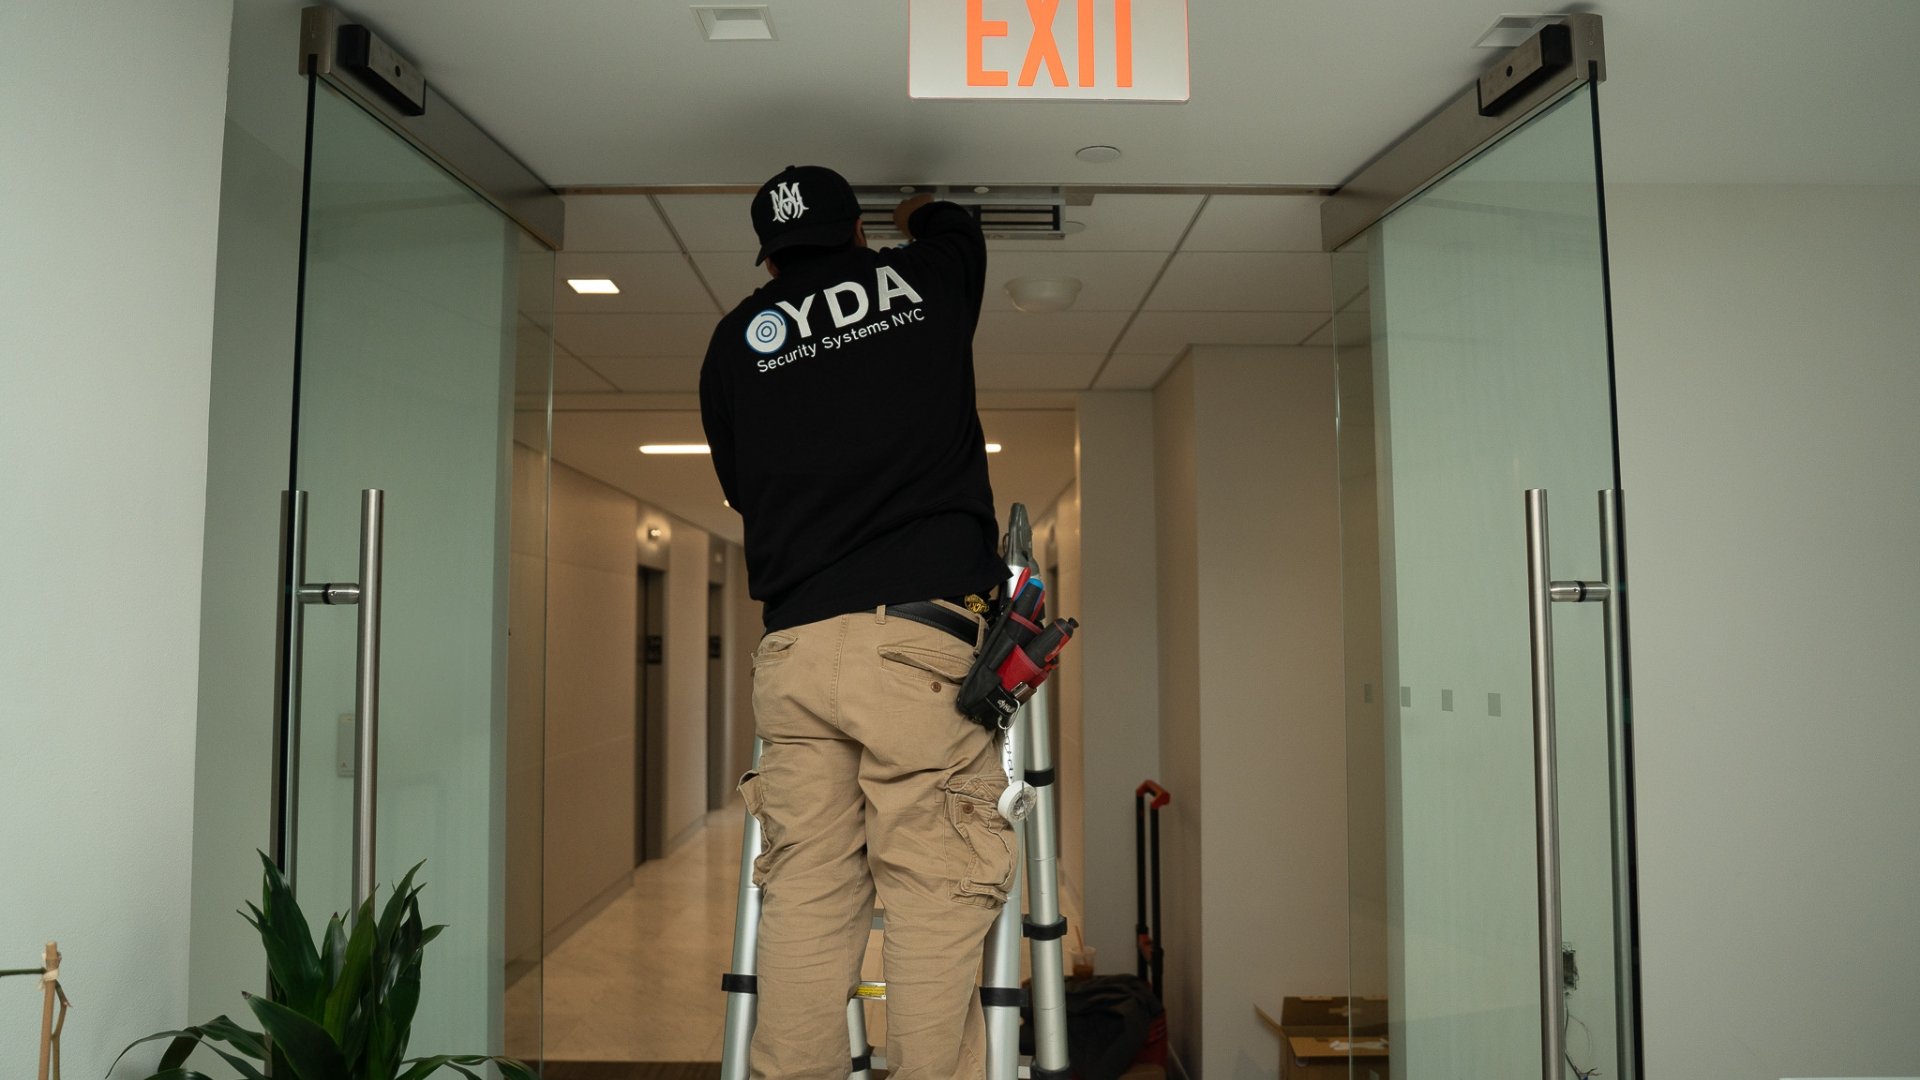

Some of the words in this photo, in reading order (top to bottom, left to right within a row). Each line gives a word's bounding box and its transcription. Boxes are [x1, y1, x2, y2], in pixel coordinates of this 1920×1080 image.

[756, 342, 817, 373] Security
[821, 320, 890, 350] Systems
[891, 308, 926, 328] NYC
